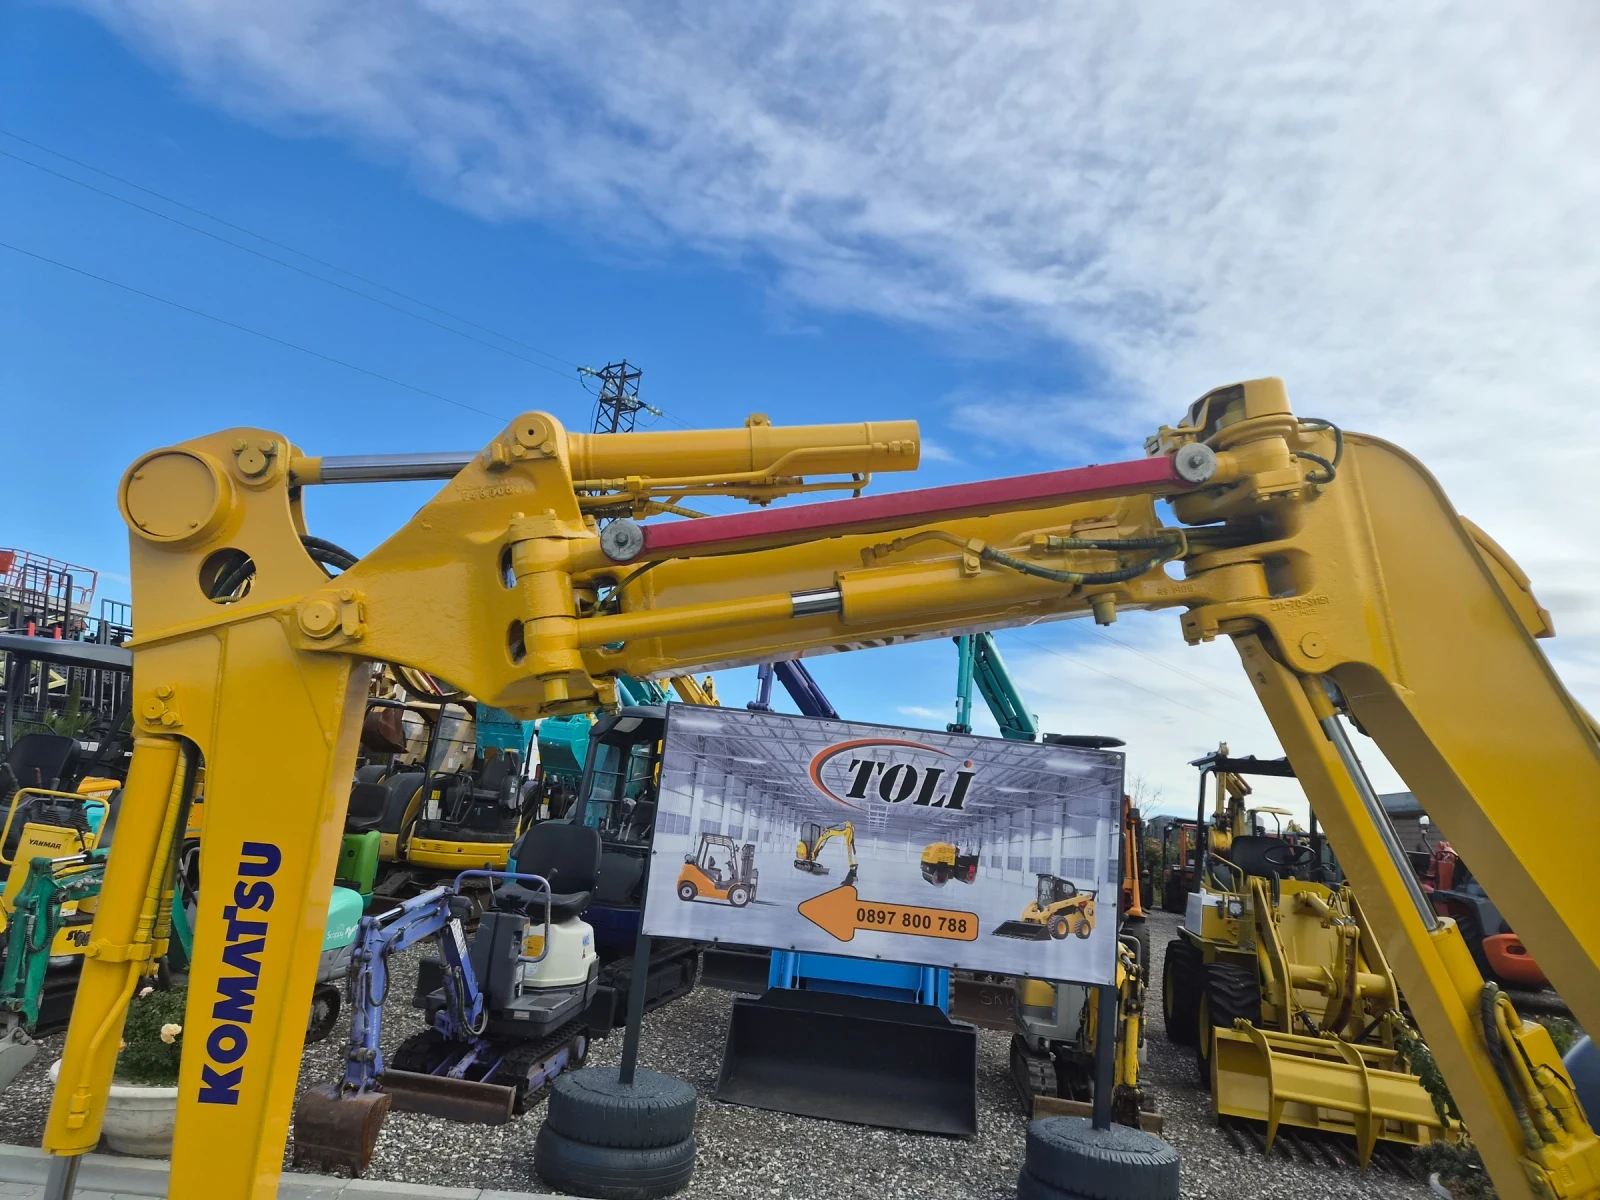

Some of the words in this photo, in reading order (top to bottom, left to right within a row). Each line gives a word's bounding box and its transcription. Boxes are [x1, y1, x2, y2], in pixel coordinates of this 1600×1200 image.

[29, 838, 62, 850] YANMAR
[856, 907, 896, 926] 0897
[902, 912, 932, 930] 800
[938, 916, 967, 934] 788
[197, 841, 282, 1106] KOMATSU
